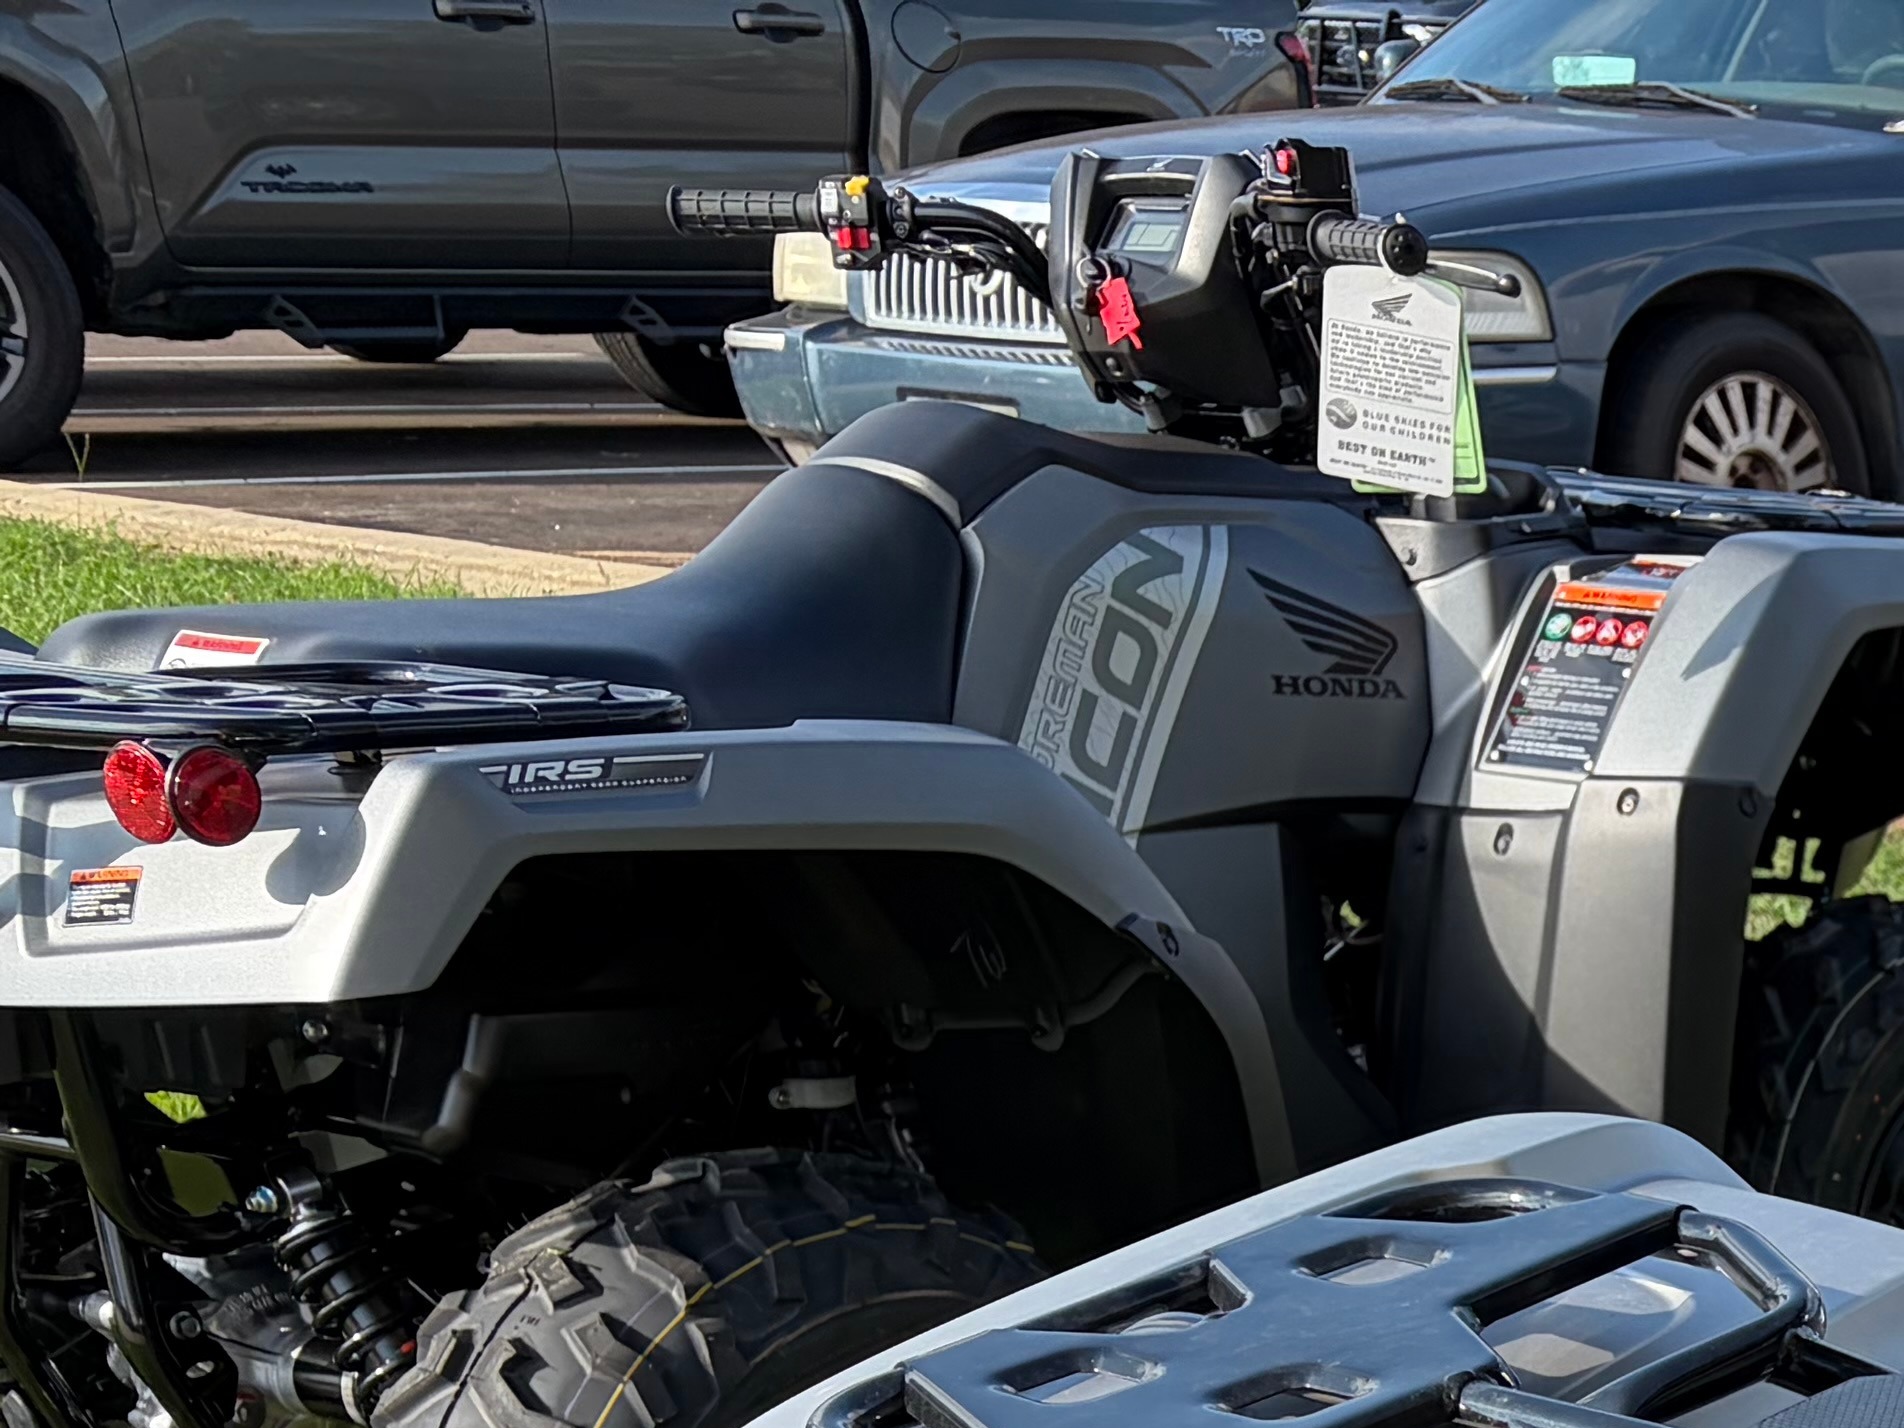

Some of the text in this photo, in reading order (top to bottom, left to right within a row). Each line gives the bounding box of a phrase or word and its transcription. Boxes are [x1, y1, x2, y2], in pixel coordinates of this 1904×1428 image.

[1216, 26, 1265, 48] TRD
[1362, 408, 1390, 424] BLUE
[1338, 439, 1368, 455] BEST
[1270, 674, 1407, 699] HONDA
[508, 758, 605, 784] IRS
